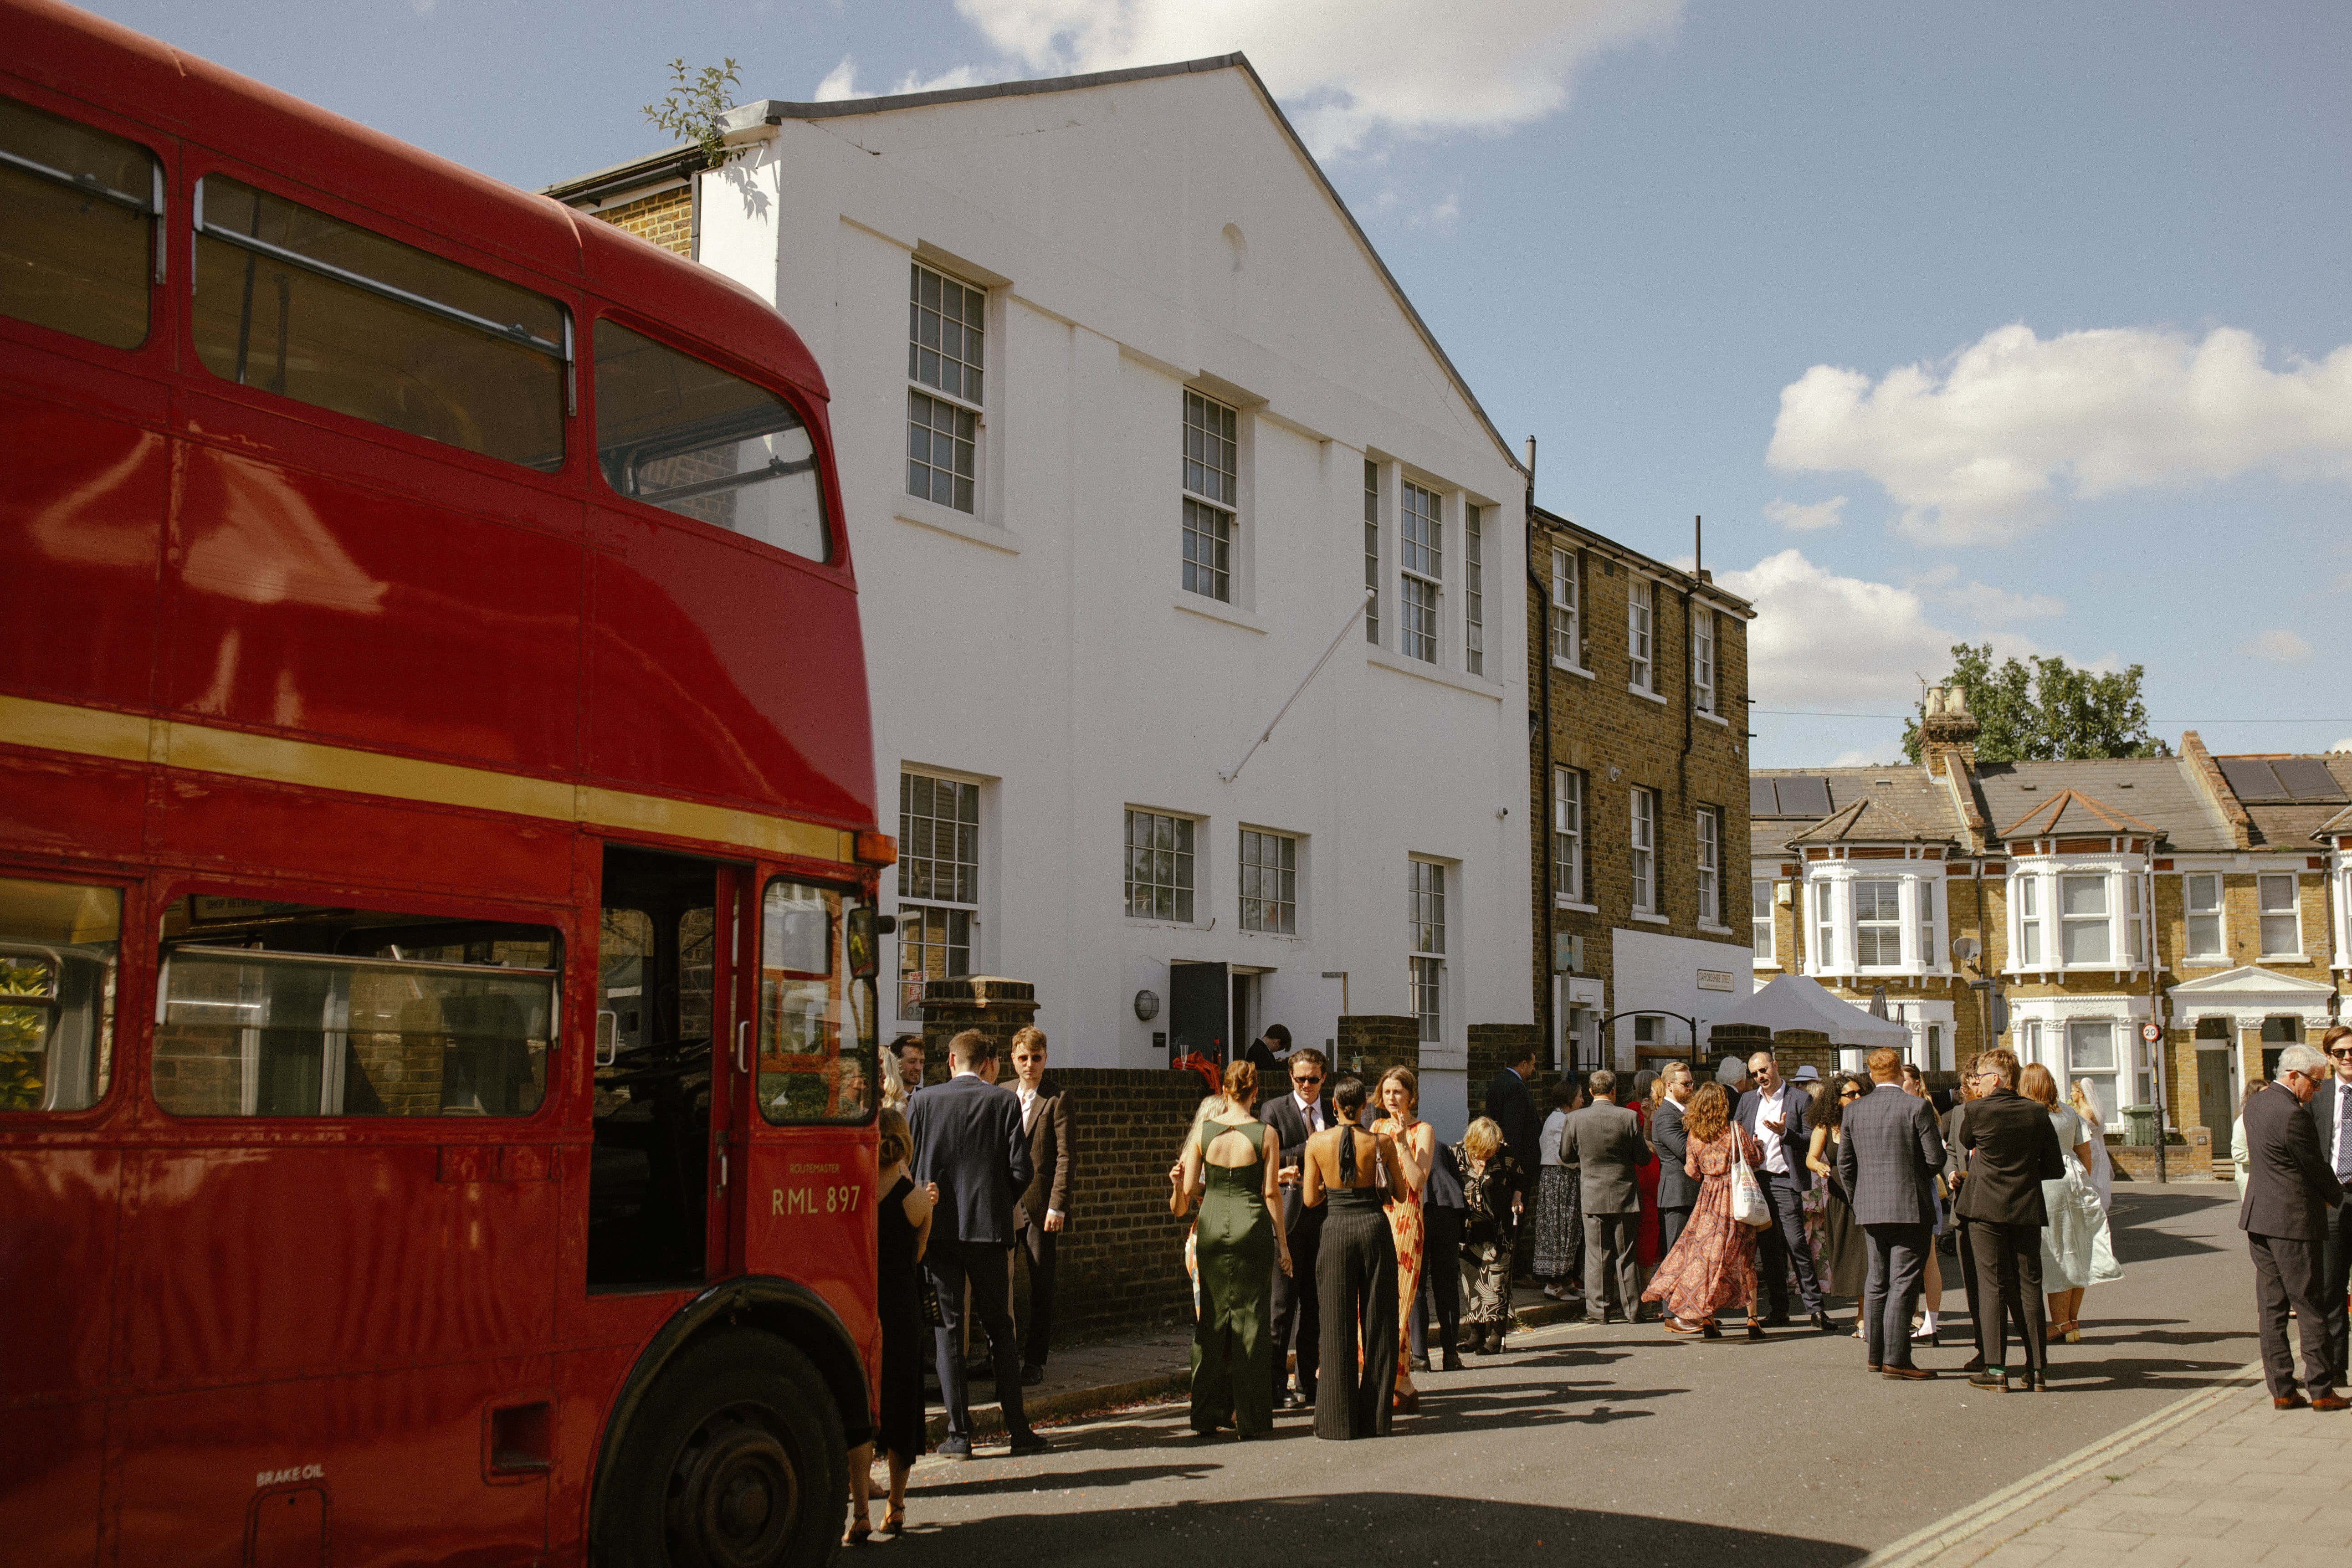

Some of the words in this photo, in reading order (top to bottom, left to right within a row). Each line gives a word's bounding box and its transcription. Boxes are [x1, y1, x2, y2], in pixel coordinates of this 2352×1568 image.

[789, 1163, 840, 1174] ROUTEMASTER
[772, 1187, 818, 1216] RML
[826, 1185, 860, 1213] 897
[256, 1466, 300, 1487] BRAKE
[302, 1464, 324, 1479] OIL
